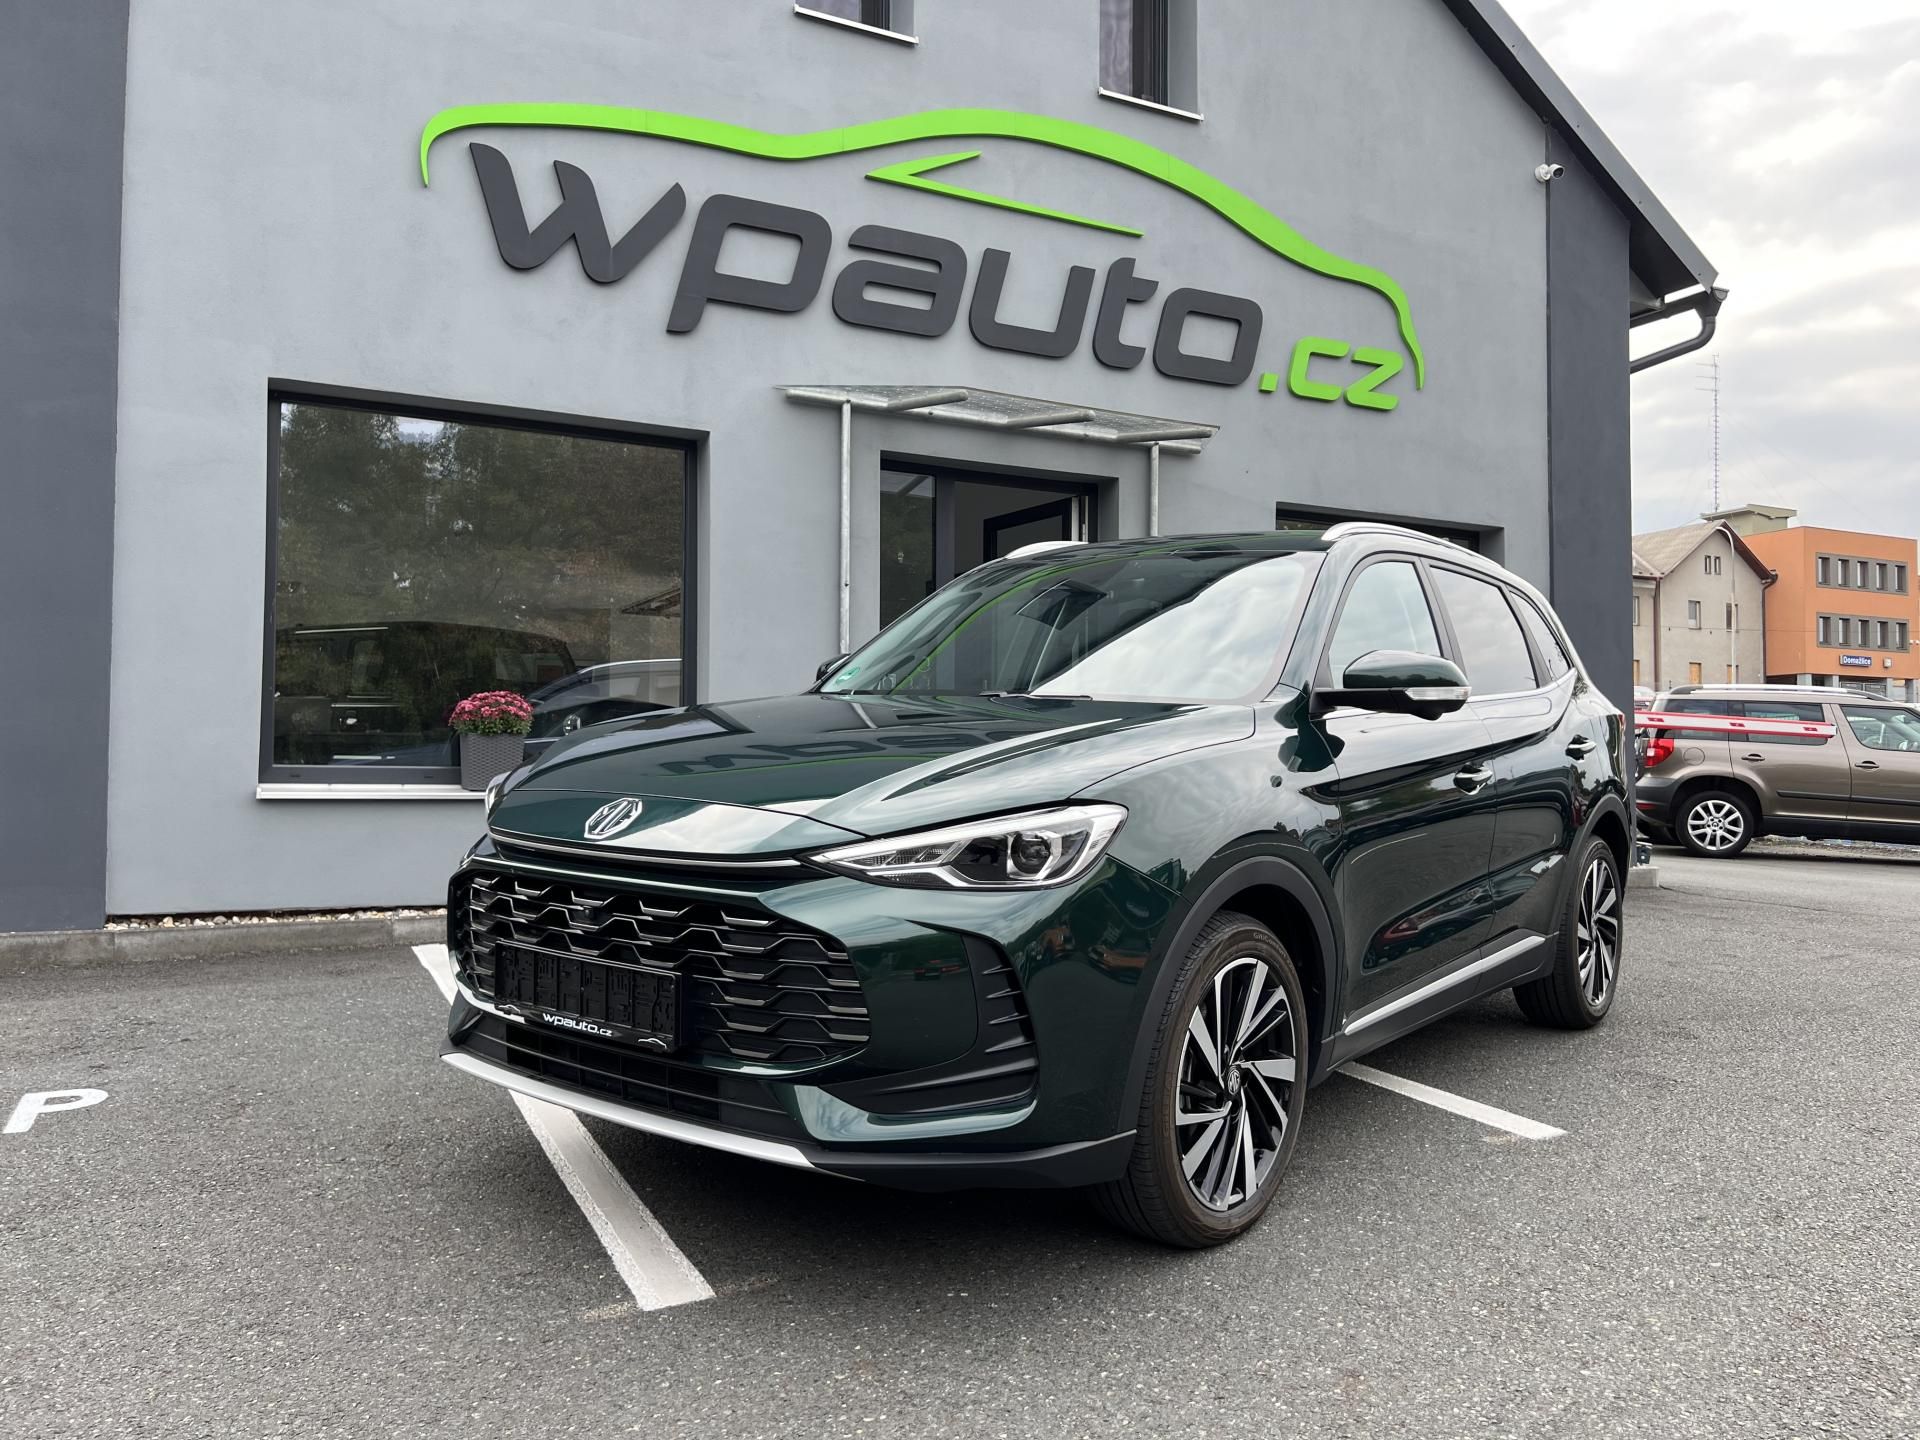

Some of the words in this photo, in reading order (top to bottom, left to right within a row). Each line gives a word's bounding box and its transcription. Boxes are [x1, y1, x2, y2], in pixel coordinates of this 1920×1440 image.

[470, 143, 1400, 411] wpauto.cz
[1843, 655, 1871, 665] Domažlice
[587, 799, 641, 837] MG
[542, 1012, 613, 1037] wpauto.cz
[2, 1088, 109, 1134] P
